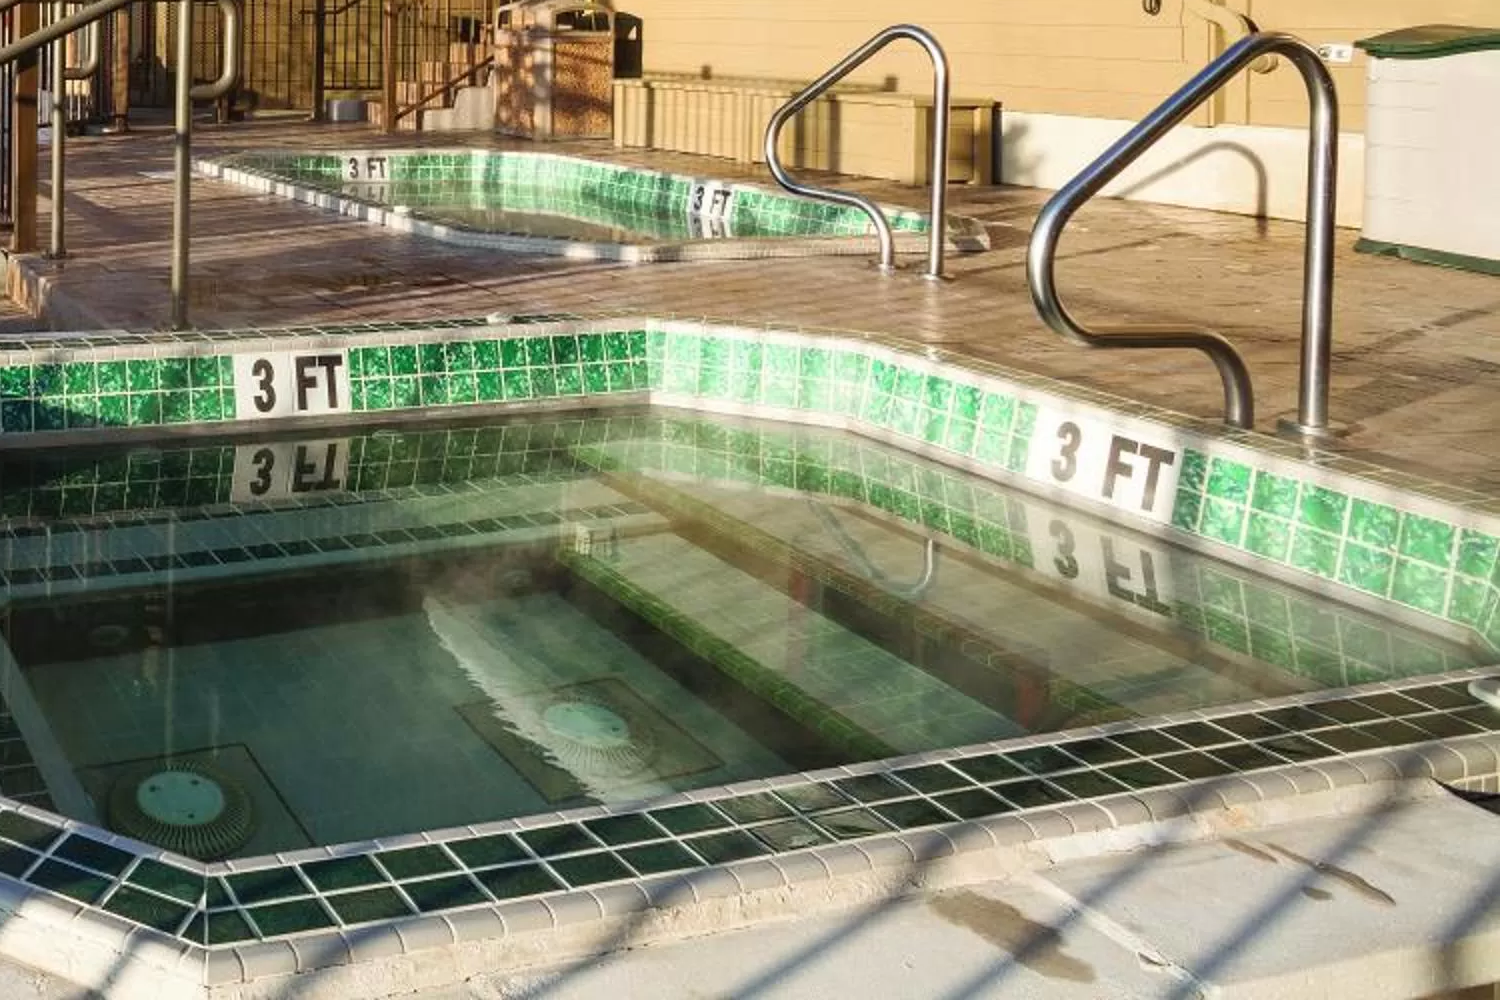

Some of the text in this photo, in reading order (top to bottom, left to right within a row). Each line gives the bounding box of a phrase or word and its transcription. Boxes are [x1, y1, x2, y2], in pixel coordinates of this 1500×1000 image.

[349, 157, 386, 179] 3 FT
[693, 185, 732, 216] 3 FT
[251, 353, 343, 413] 3 FT
[1051, 421, 1175, 513] 3 FT
